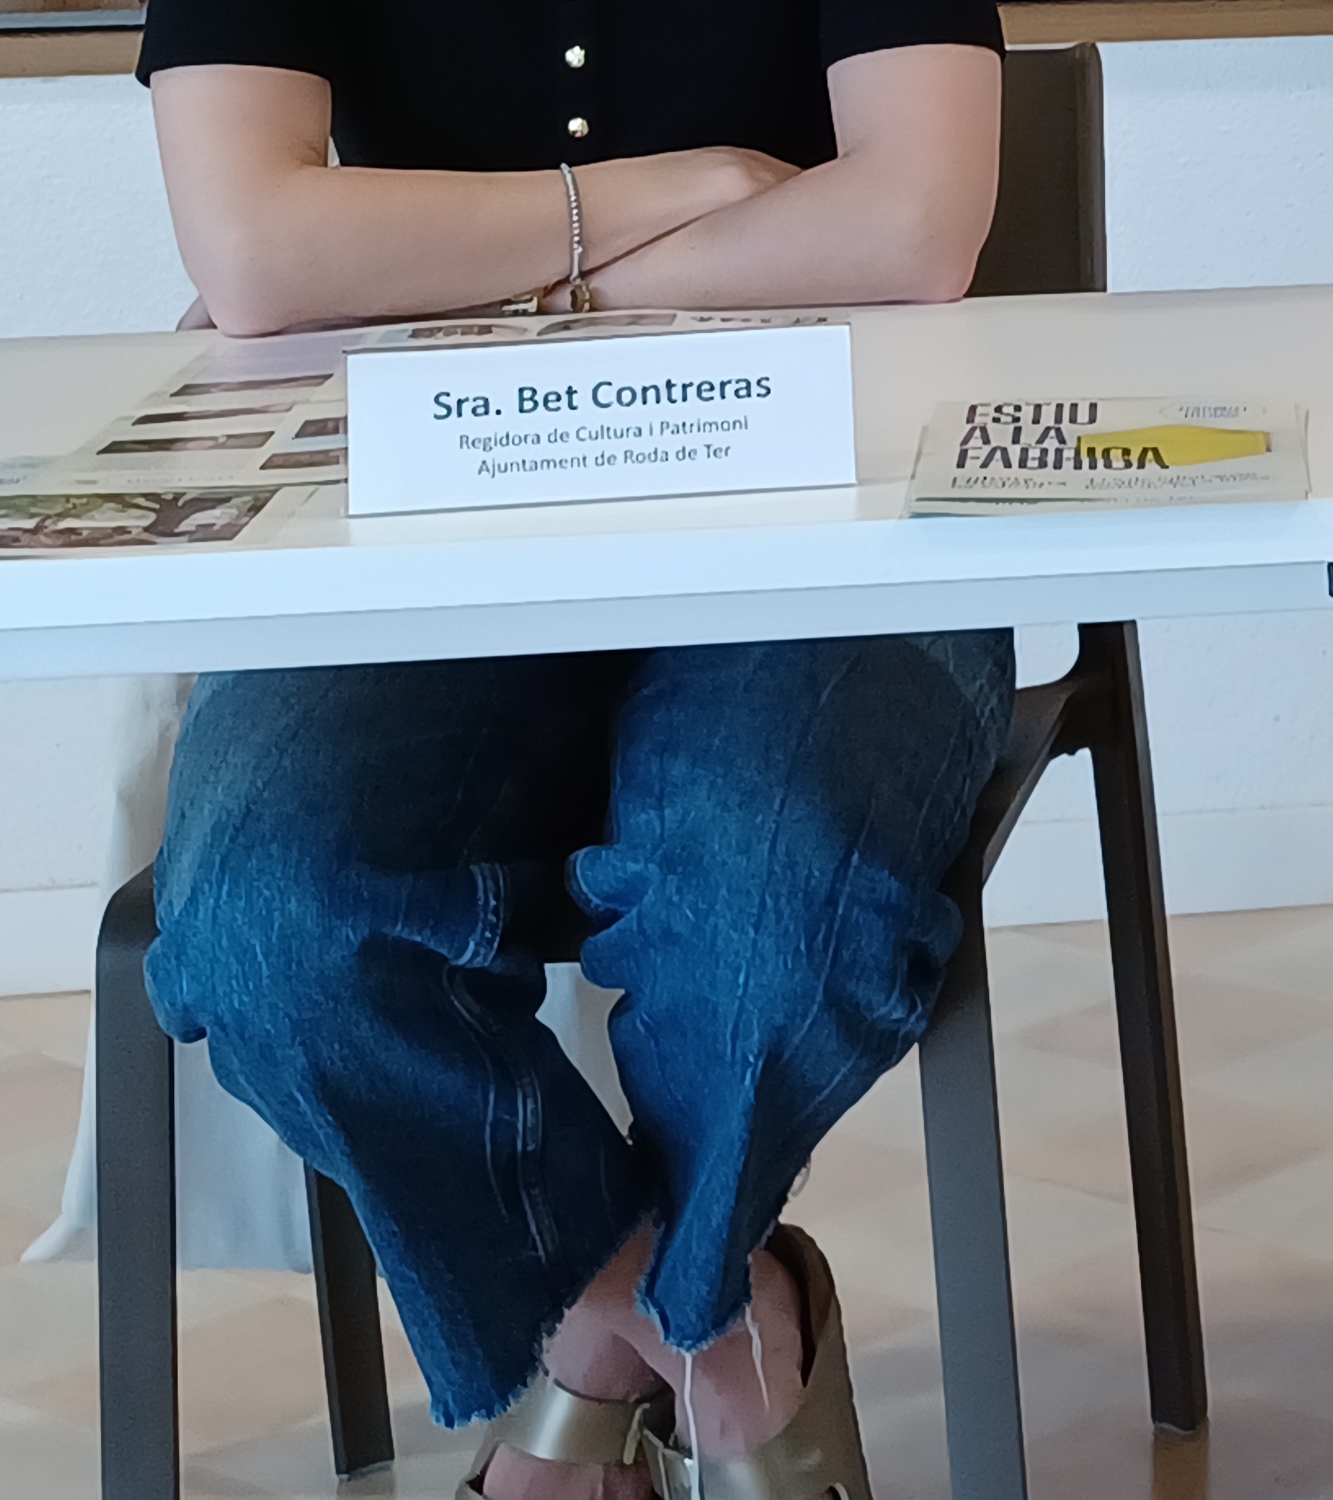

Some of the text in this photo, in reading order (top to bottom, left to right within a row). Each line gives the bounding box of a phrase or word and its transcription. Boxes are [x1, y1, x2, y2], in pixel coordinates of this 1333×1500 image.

[433, 376, 772, 421] Sra. Bet Contreras
[966, 402, 1097, 425] ESTIU
[459, 431, 541, 452] Regidora
[547, 428, 570, 444] de
[575, 424, 642, 442] Cultura
[660, 415, 749, 437] Patrimoni
[478, 443, 731, 478] Ajuntament de Roda de Ter
